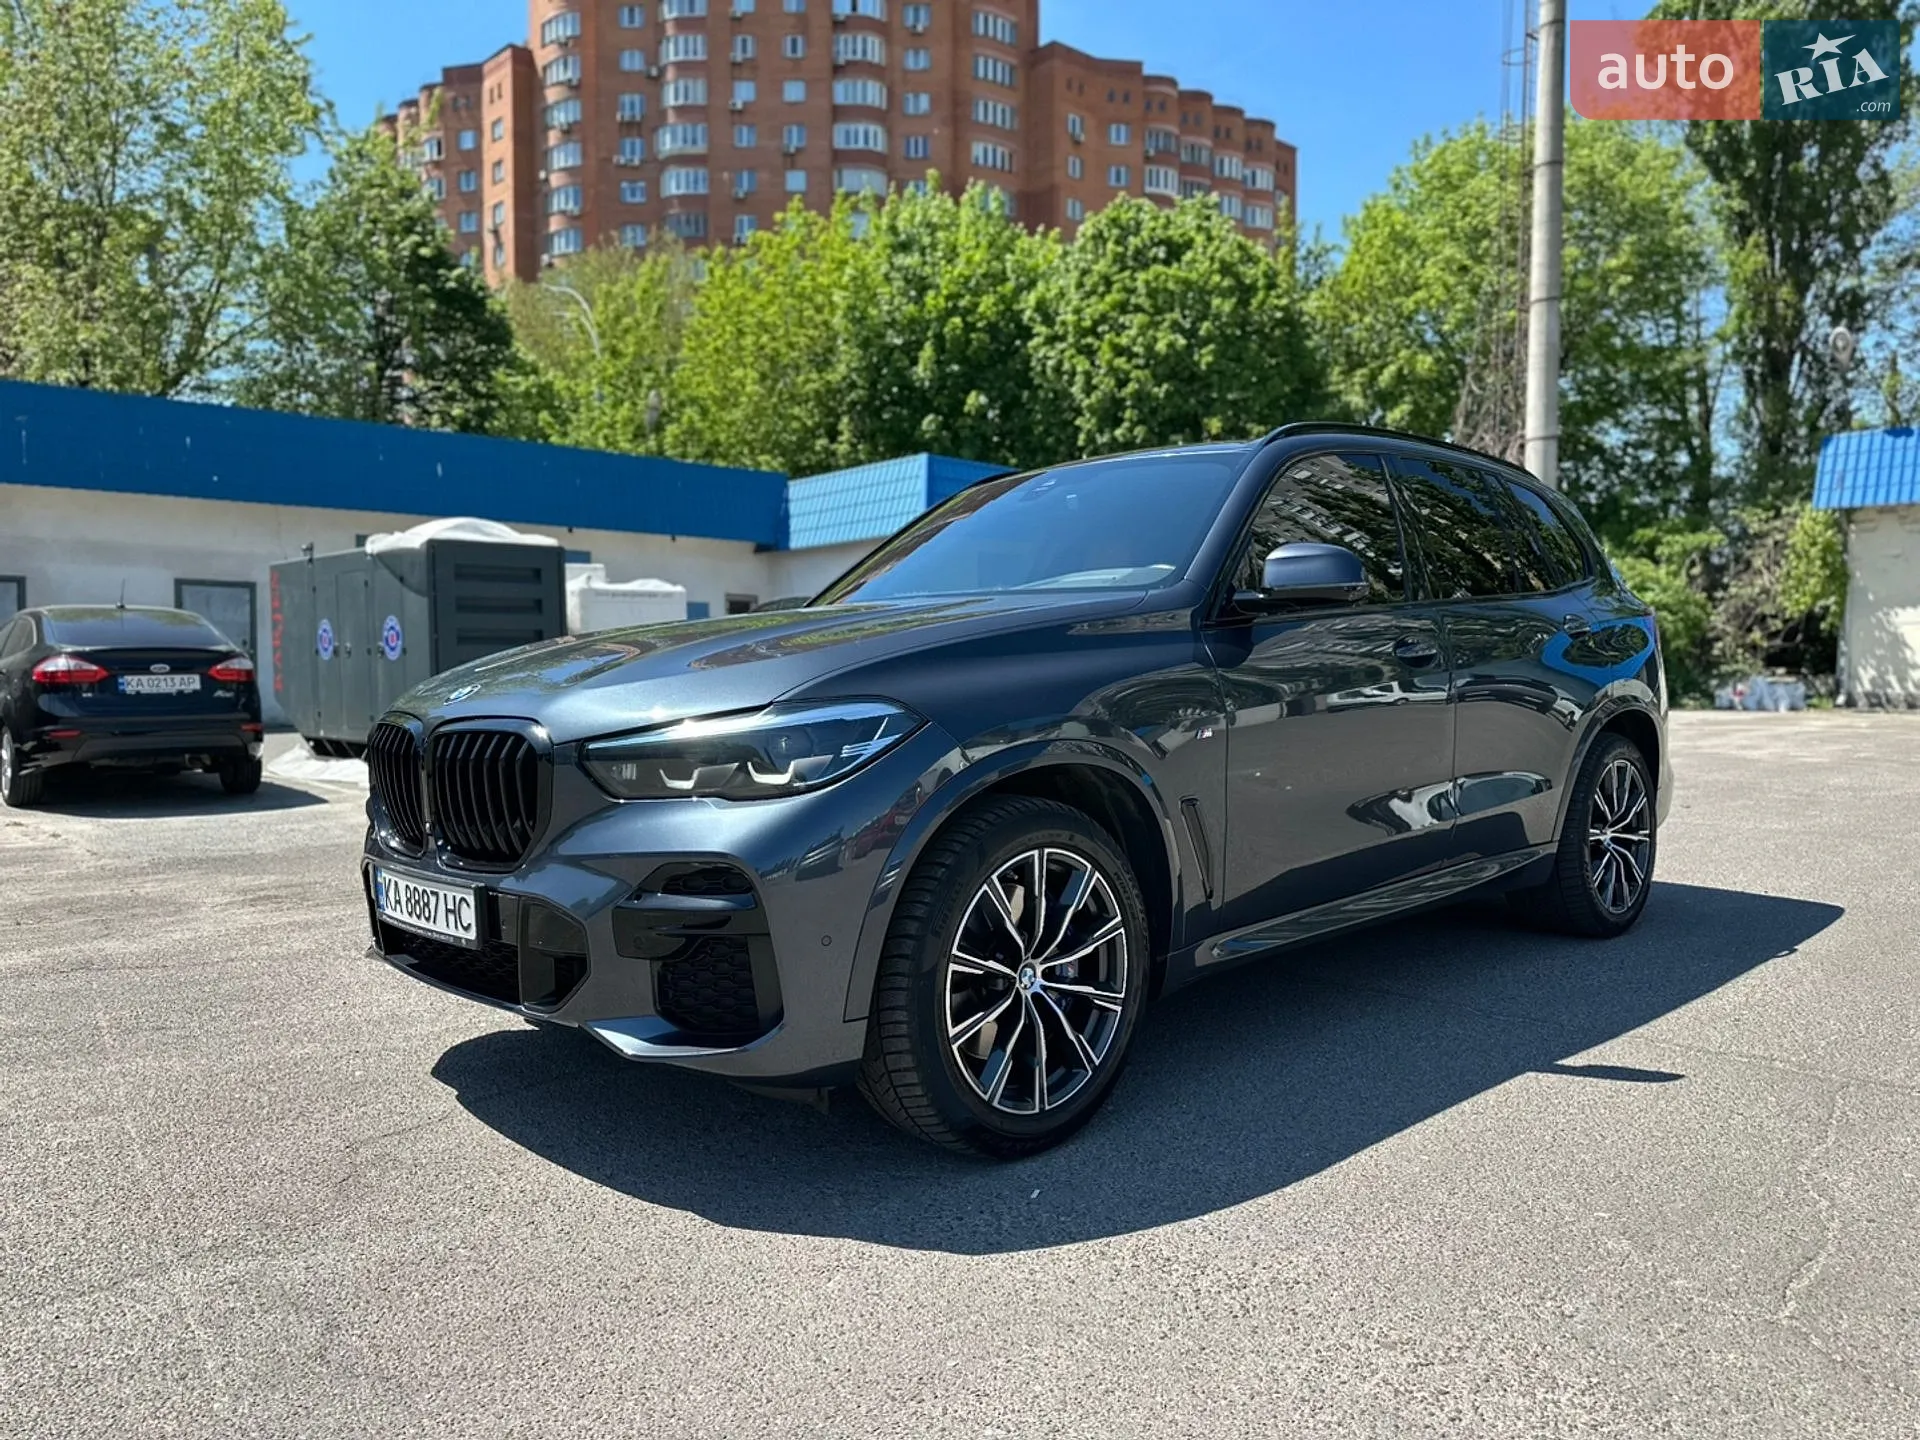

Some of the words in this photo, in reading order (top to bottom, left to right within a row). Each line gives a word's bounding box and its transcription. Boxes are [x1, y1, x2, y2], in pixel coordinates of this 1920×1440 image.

[127, 677, 144, 689] KA
[147, 677, 176, 689] 0213
[179, 676, 196, 688] AP
[383, 876, 404, 915] KA
[405, 884, 439, 925] 8887
[443, 893, 472, 932] HC
